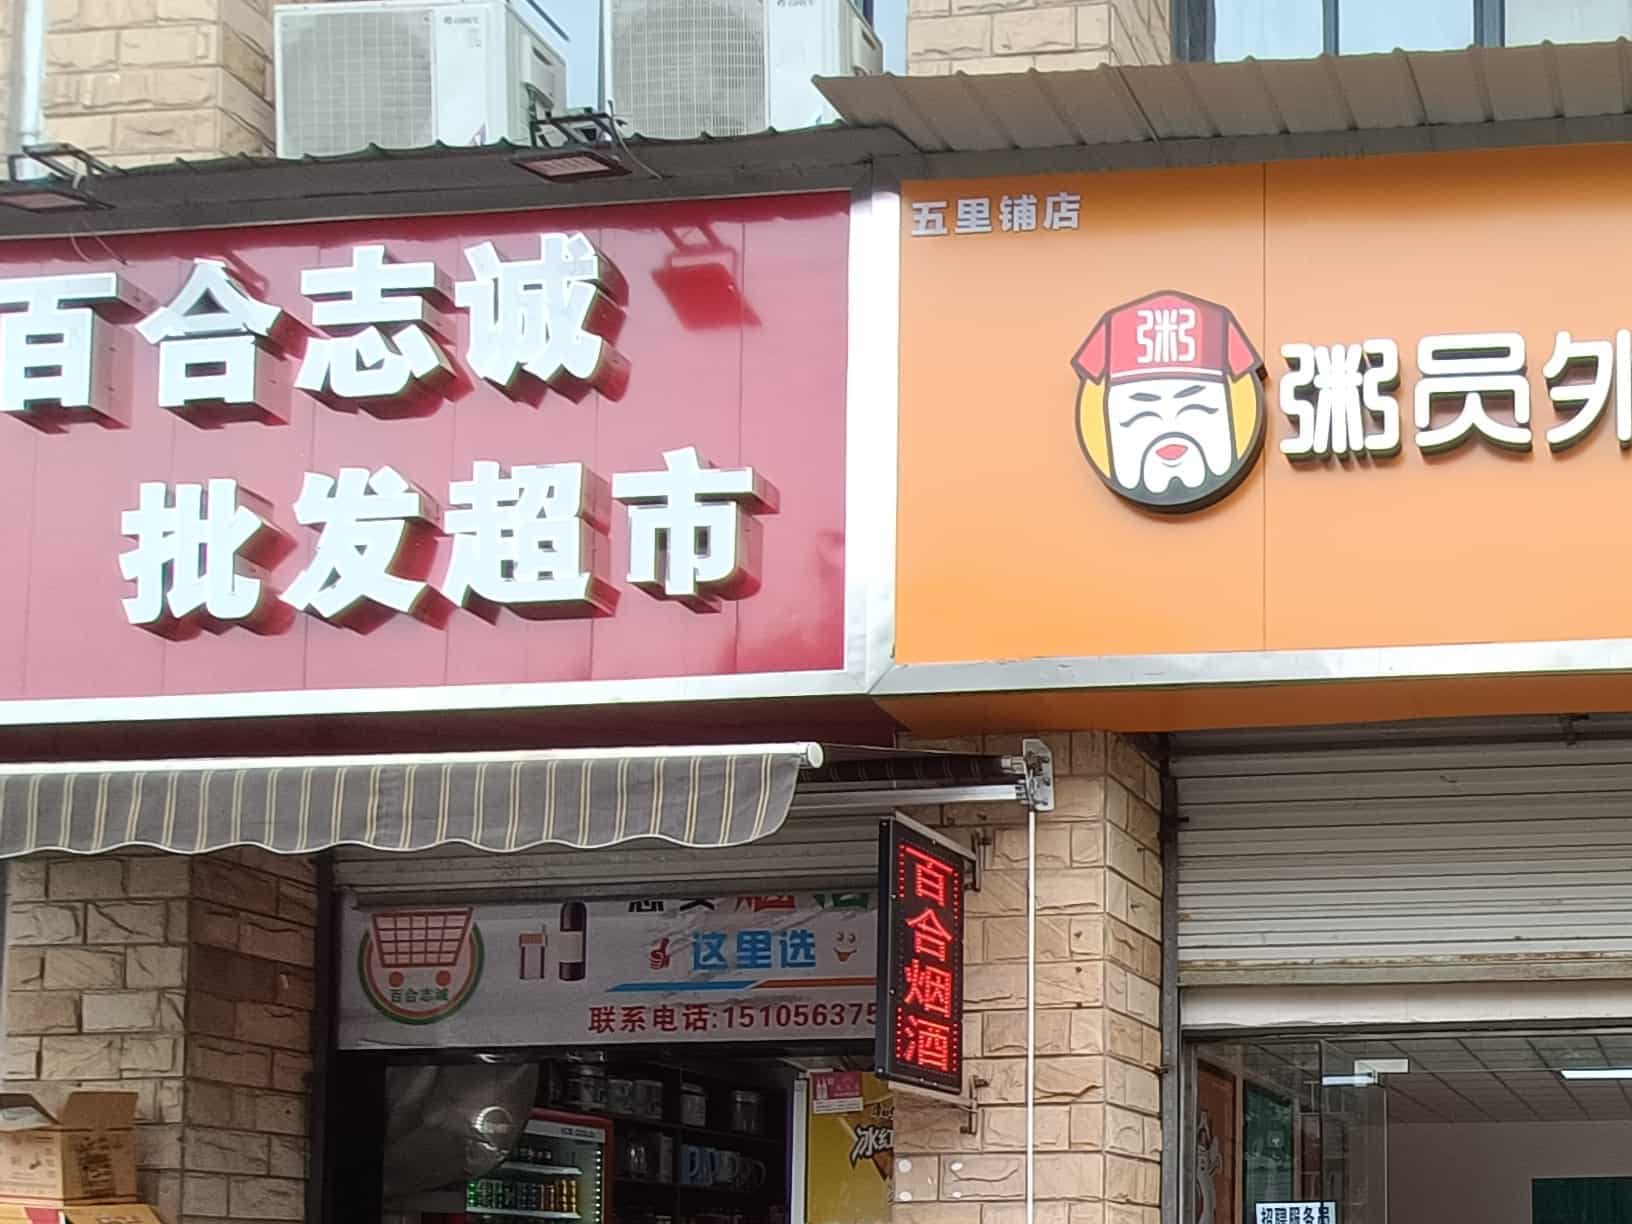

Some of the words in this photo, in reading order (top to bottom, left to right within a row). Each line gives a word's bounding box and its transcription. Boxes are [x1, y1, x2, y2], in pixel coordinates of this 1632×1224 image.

[911, 193, 1081, 236] 五里铺店
[0, 232, 606, 412] 百合志诚
[1136, 308, 1196, 363] 粥
[119, 446, 756, 626] 批发超市
[692, 929, 816, 970] 这里选
[904, 847, 953, 1072] 百合烟酒
